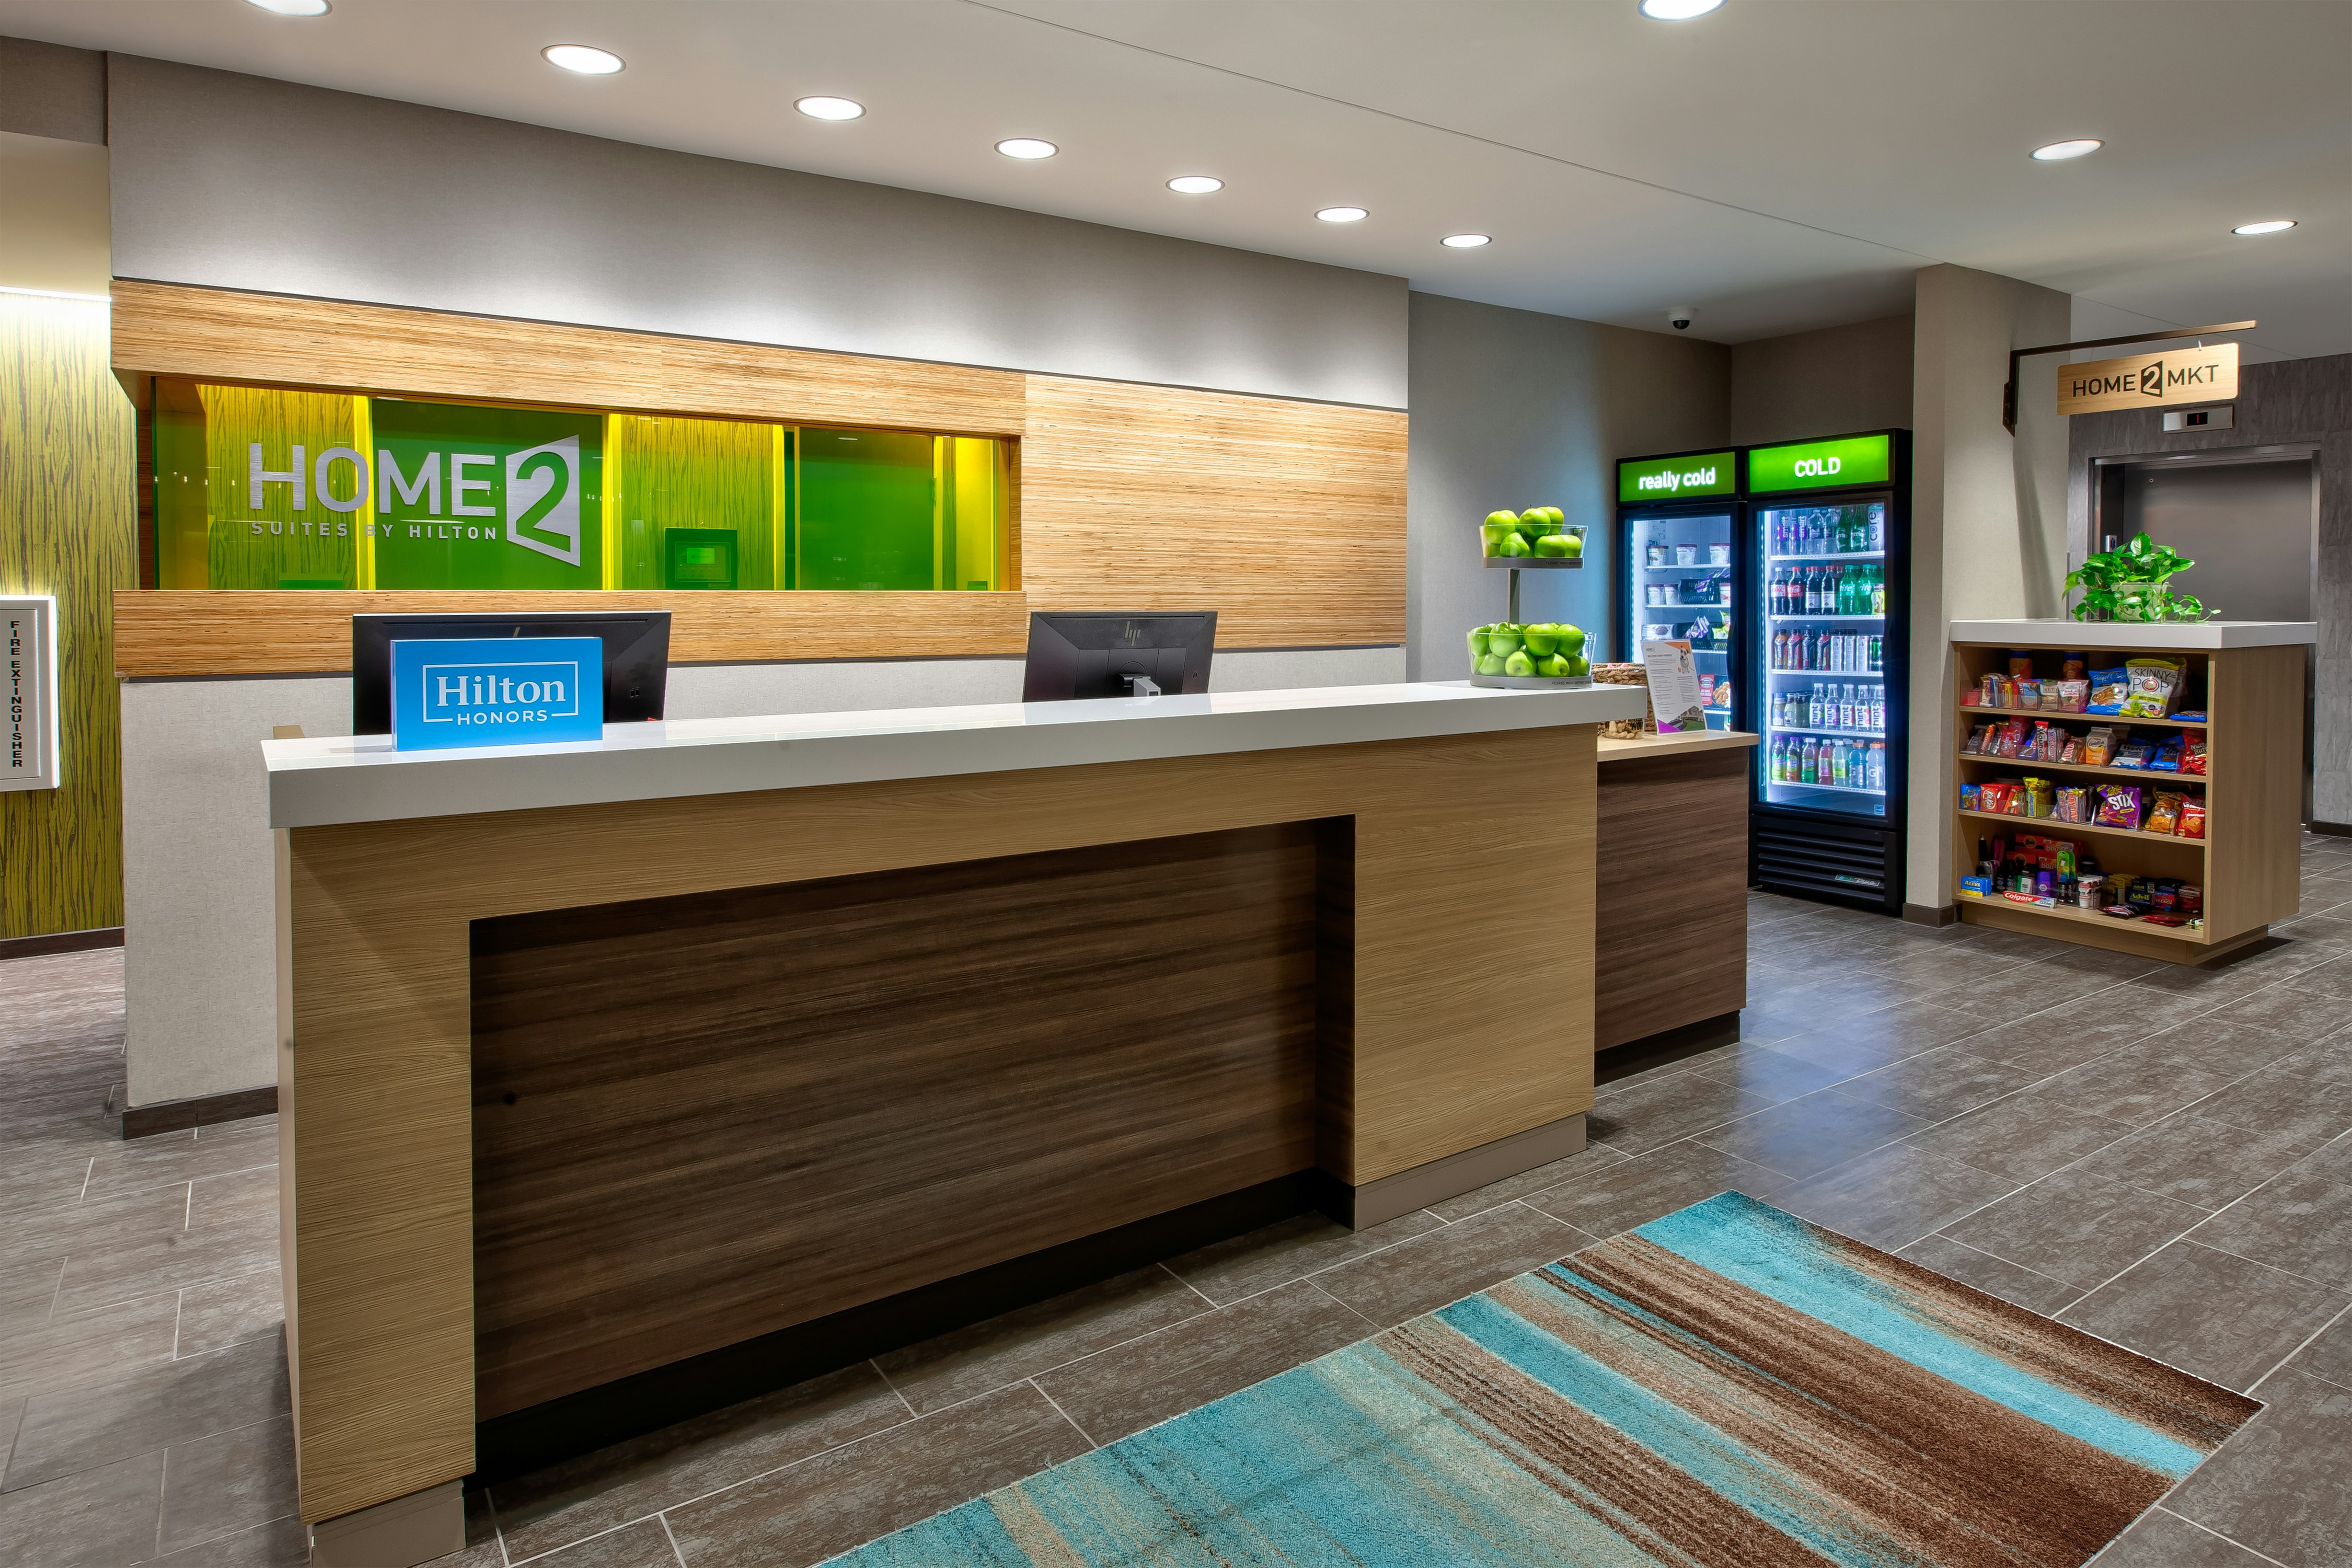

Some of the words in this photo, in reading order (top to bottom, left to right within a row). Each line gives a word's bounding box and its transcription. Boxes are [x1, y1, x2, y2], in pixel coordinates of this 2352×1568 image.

[2167, 364, 2219, 386] MKT
[2196, 413, 2200, 424] 1
[1794, 457, 1841, 477] COLD
[1639, 471, 1680, 491] really
[1683, 467, 1716, 487] cold
[252, 521, 348, 537] SUITES
[365, 524, 393, 538] BY
[409, 525, 497, 540] HILTON
[1869, 511, 1878, 541] core
[10, 620, 20, 655] FIRE
[1124, 621, 1142, 647] hp
[2134, 667, 2171, 681] SKINNY
[436, 675, 566, 707] Hilton
[2131, 677, 2170, 693] POP
[10, 661, 22, 767] EXTINGUISHER
[457, 709, 548, 725] HONORS
[2108, 791, 2136, 810] STIX
[2004, 892, 2034, 902] Colgate
